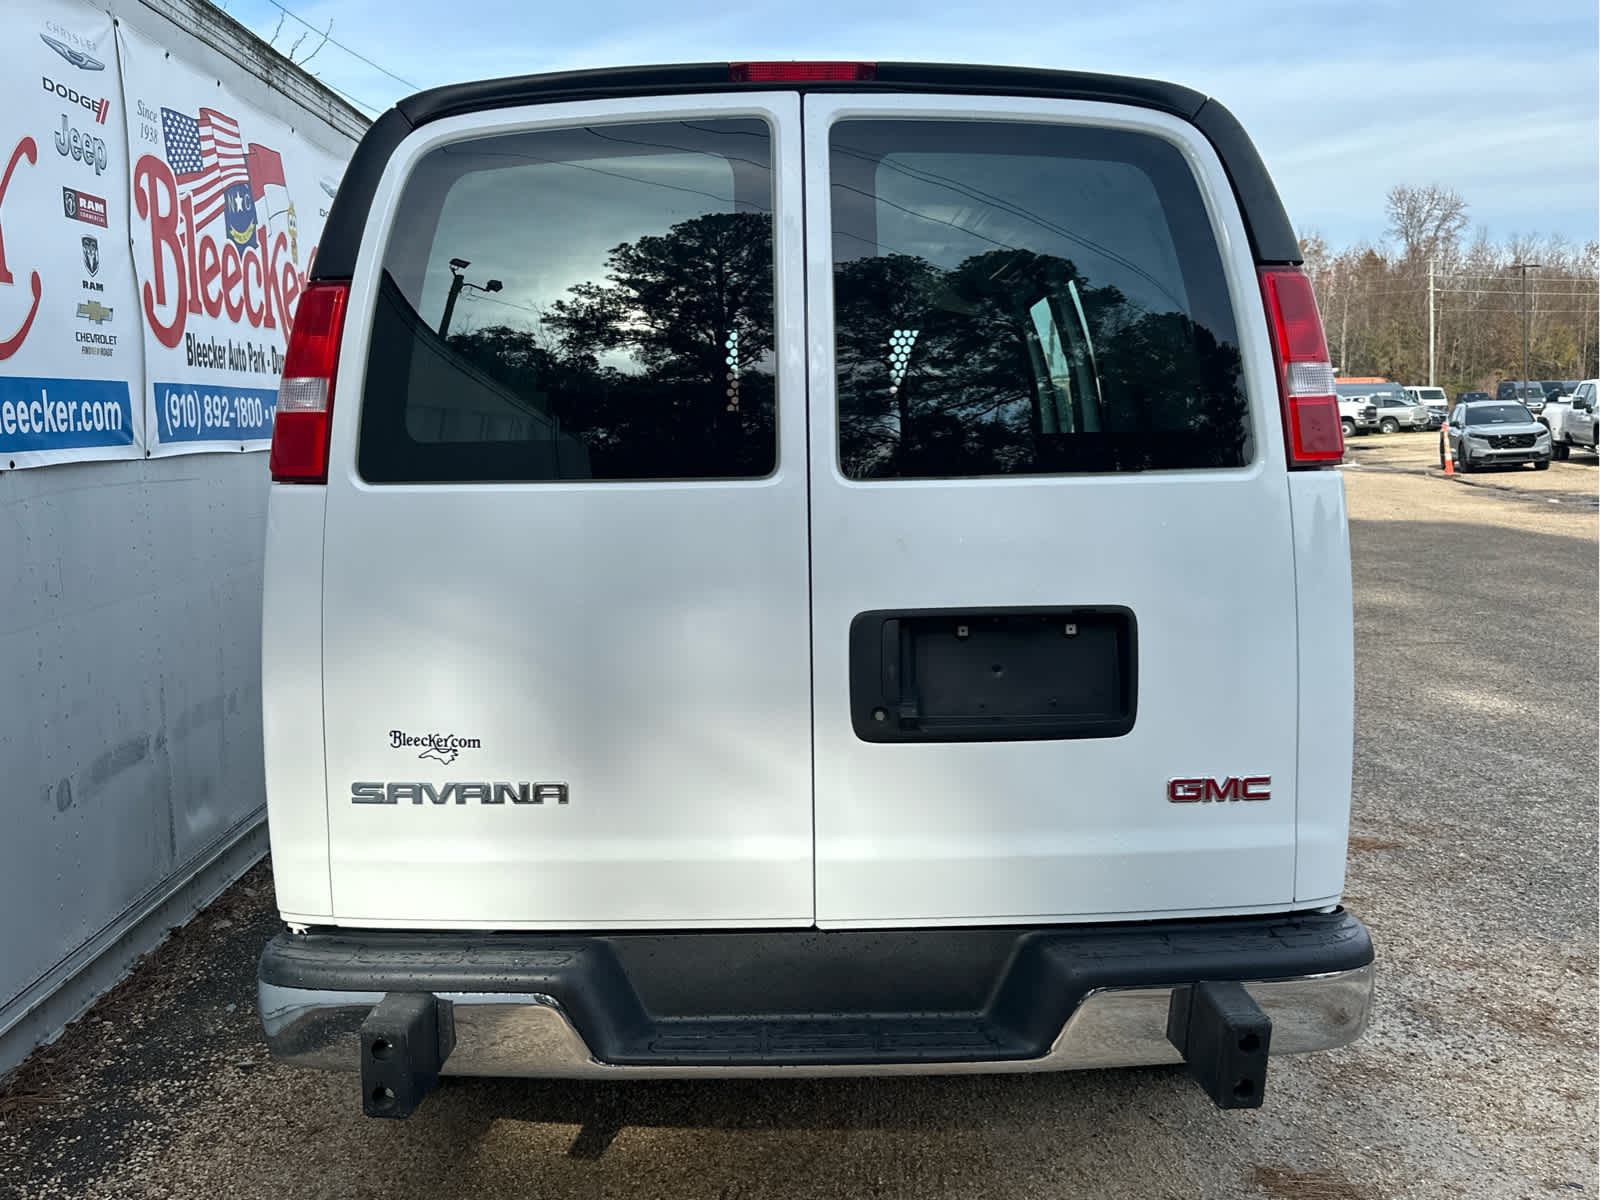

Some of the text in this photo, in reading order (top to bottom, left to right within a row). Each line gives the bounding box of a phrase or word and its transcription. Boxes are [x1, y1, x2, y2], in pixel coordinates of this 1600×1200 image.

[46, 21, 97, 51] CHRYSLER
[42, 77, 102, 113] DODGE
[137, 99, 158, 123] Since
[55, 113, 107, 176] Jeep
[140, 122, 158, 144] 1938
[79, 198, 105, 214] RAM
[82, 280, 104, 292] RAM
[75, 331, 117, 345] CHEVROLET
[185, 332, 227, 370] Bleecker
[229, 339, 247, 372] Auto
[247, 341, 267, 374] Park
[0, 388, 122, 434] eecker.com
[165, 389, 201, 436] (910)
[203, 394, 263, 428] 892-1800
[351, 781, 569, 805] SAVANA
[1166, 775, 1272, 803] GMC
